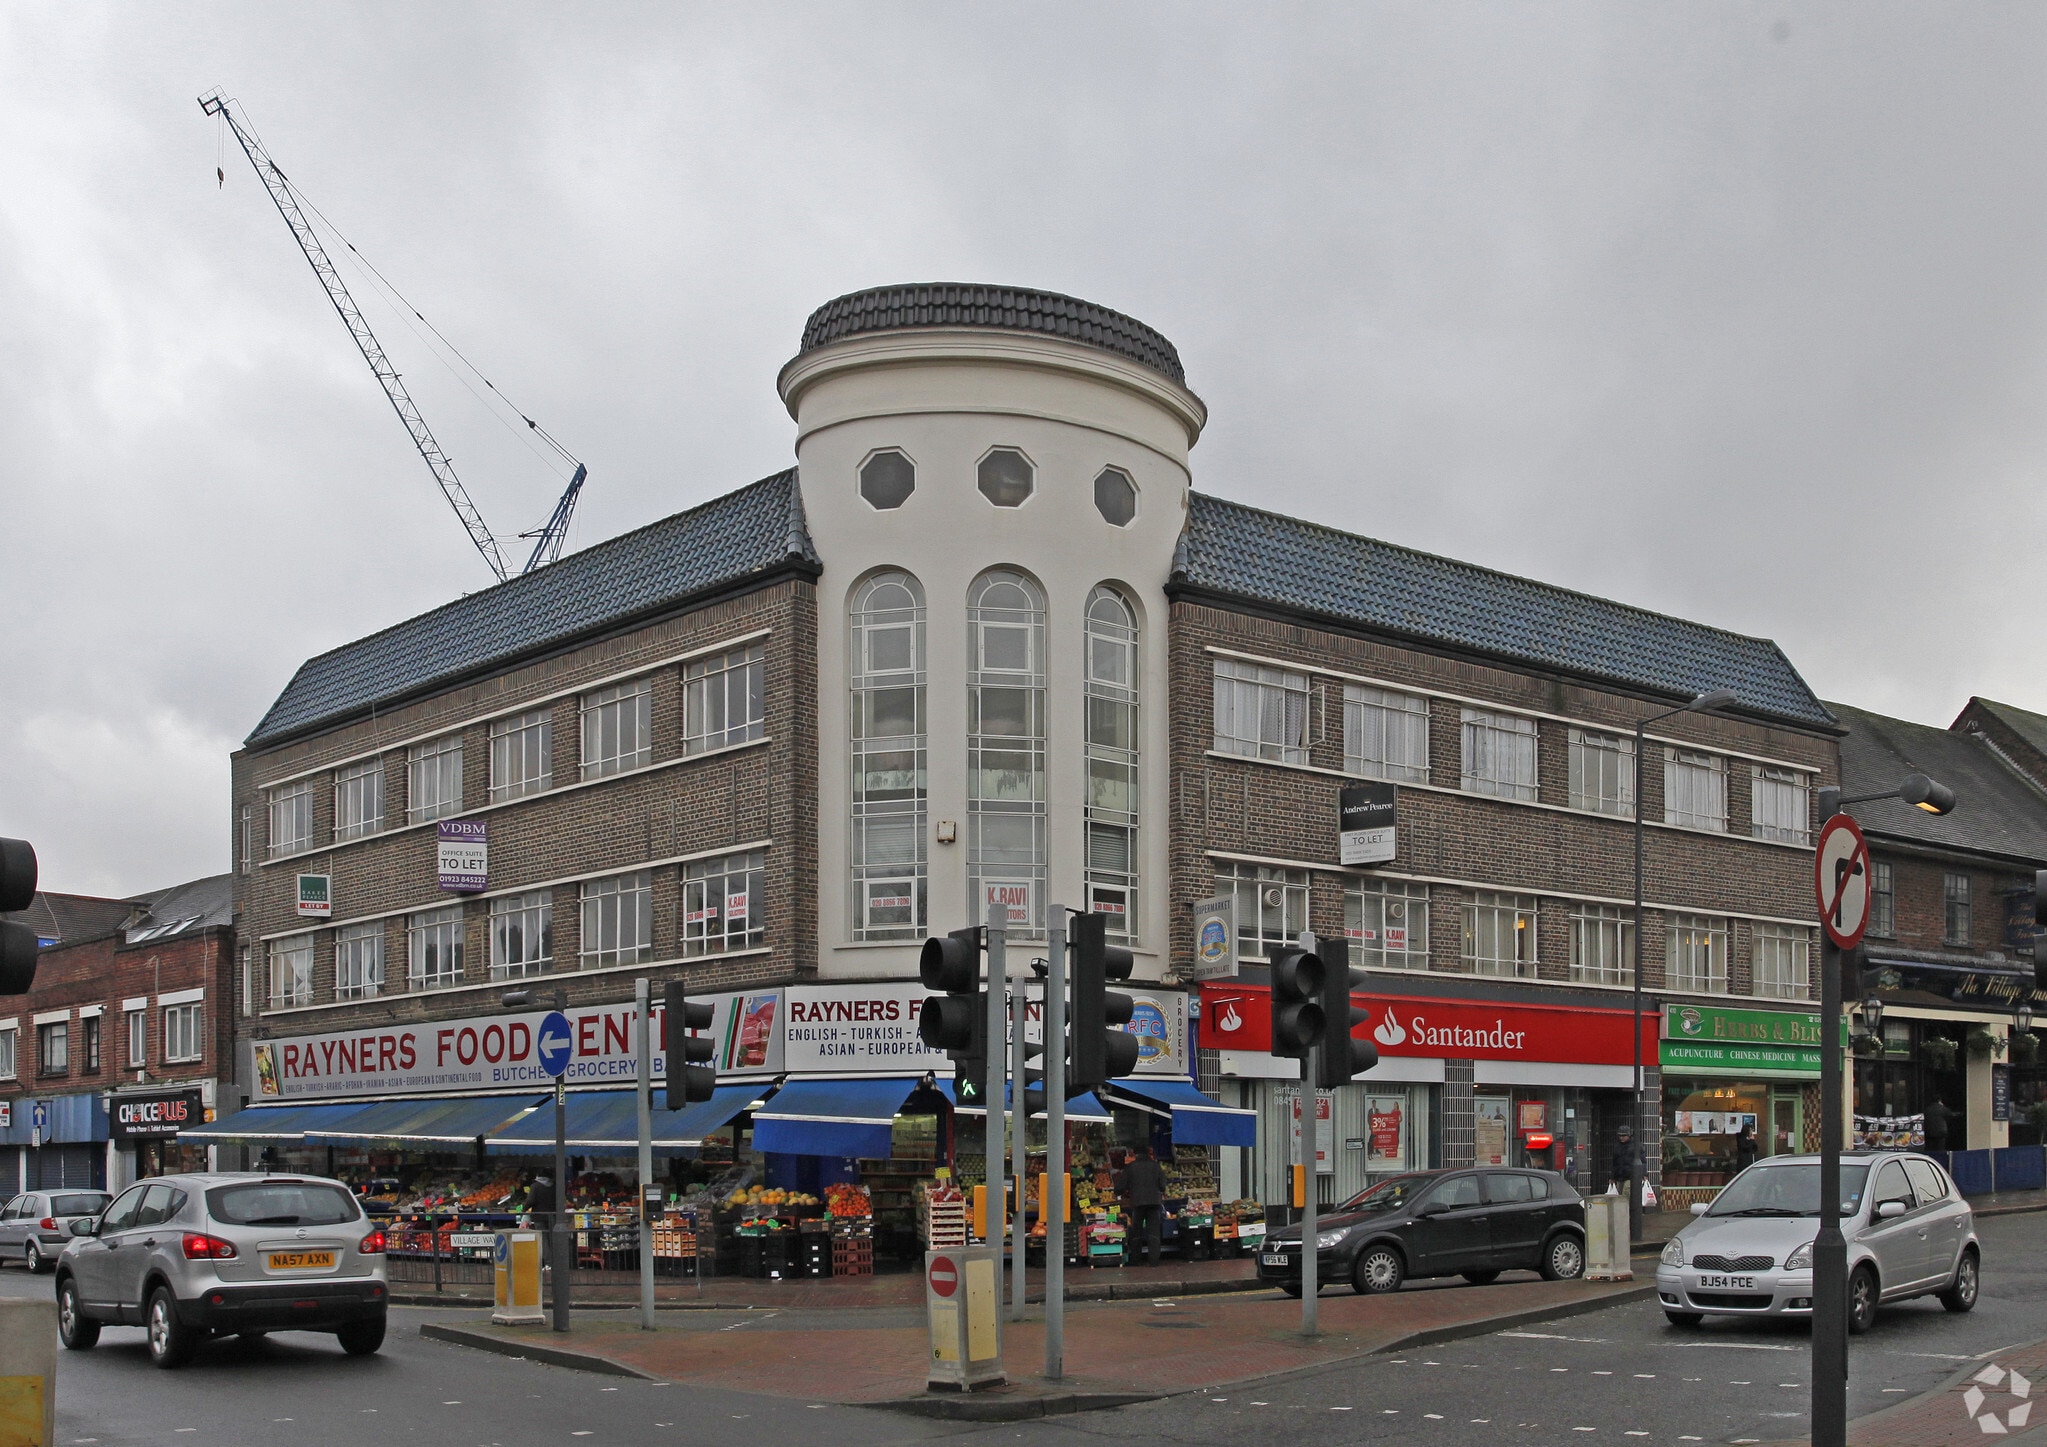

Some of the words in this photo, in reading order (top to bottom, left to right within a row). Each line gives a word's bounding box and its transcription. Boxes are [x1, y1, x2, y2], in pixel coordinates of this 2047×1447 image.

[1343, 805, 1369, 814] Andrew
[1370, 803, 1393, 811] Pearce
[440, 823, 486, 834] VDBM
[1352, 836, 1365, 845] TO
[1367, 835, 1383, 844] LET
[441, 858, 458, 868] TO
[462, 859, 484, 869] LET
[987, 886, 1027, 905] K.RAVI
[1196, 900, 1231, 915] SUPERMARKET
[1984, 975, 2022, 1006] Village
[790, 999, 900, 1022] RAYNERS
[1127, 1018, 1162, 1035] RFC
[1411, 1016, 1525, 1049] Santander
[1713, 1017, 1768, 1040] HERBS
[1773, 1021, 1784, 1040] &
[788, 1028, 838, 1041] ENGLISH
[850, 1027, 902, 1040] TURKISH
[284, 1032, 416, 1079] RAYNERS
[437, 1022, 531, 1067] FOOD
[819, 1043, 855, 1056] ASIAN
[868, 1042, 931, 1055] EUROPEAN
[1669, 1048, 1724, 1059] ACUPUNCTURE
[1729, 1051, 1760, 1060] CHINESE
[1762, 1052, 1796, 1061] MEDICINE
[566, 1059, 637, 1077] GROCERY
[406, 1075, 431, 1086] EUROPEAN
[468, 1072, 482, 1082] FOOD
[1372, 1117, 1387, 1128] 3%
[452, 1236, 480, 1244] VILLAGE
[273, 1255, 303, 1266] NA57
[307, 1255, 329, 1264] AXN
[1701, 1276, 1728, 1288] BJ54
[1731, 1277, 1753, 1288] FCE
